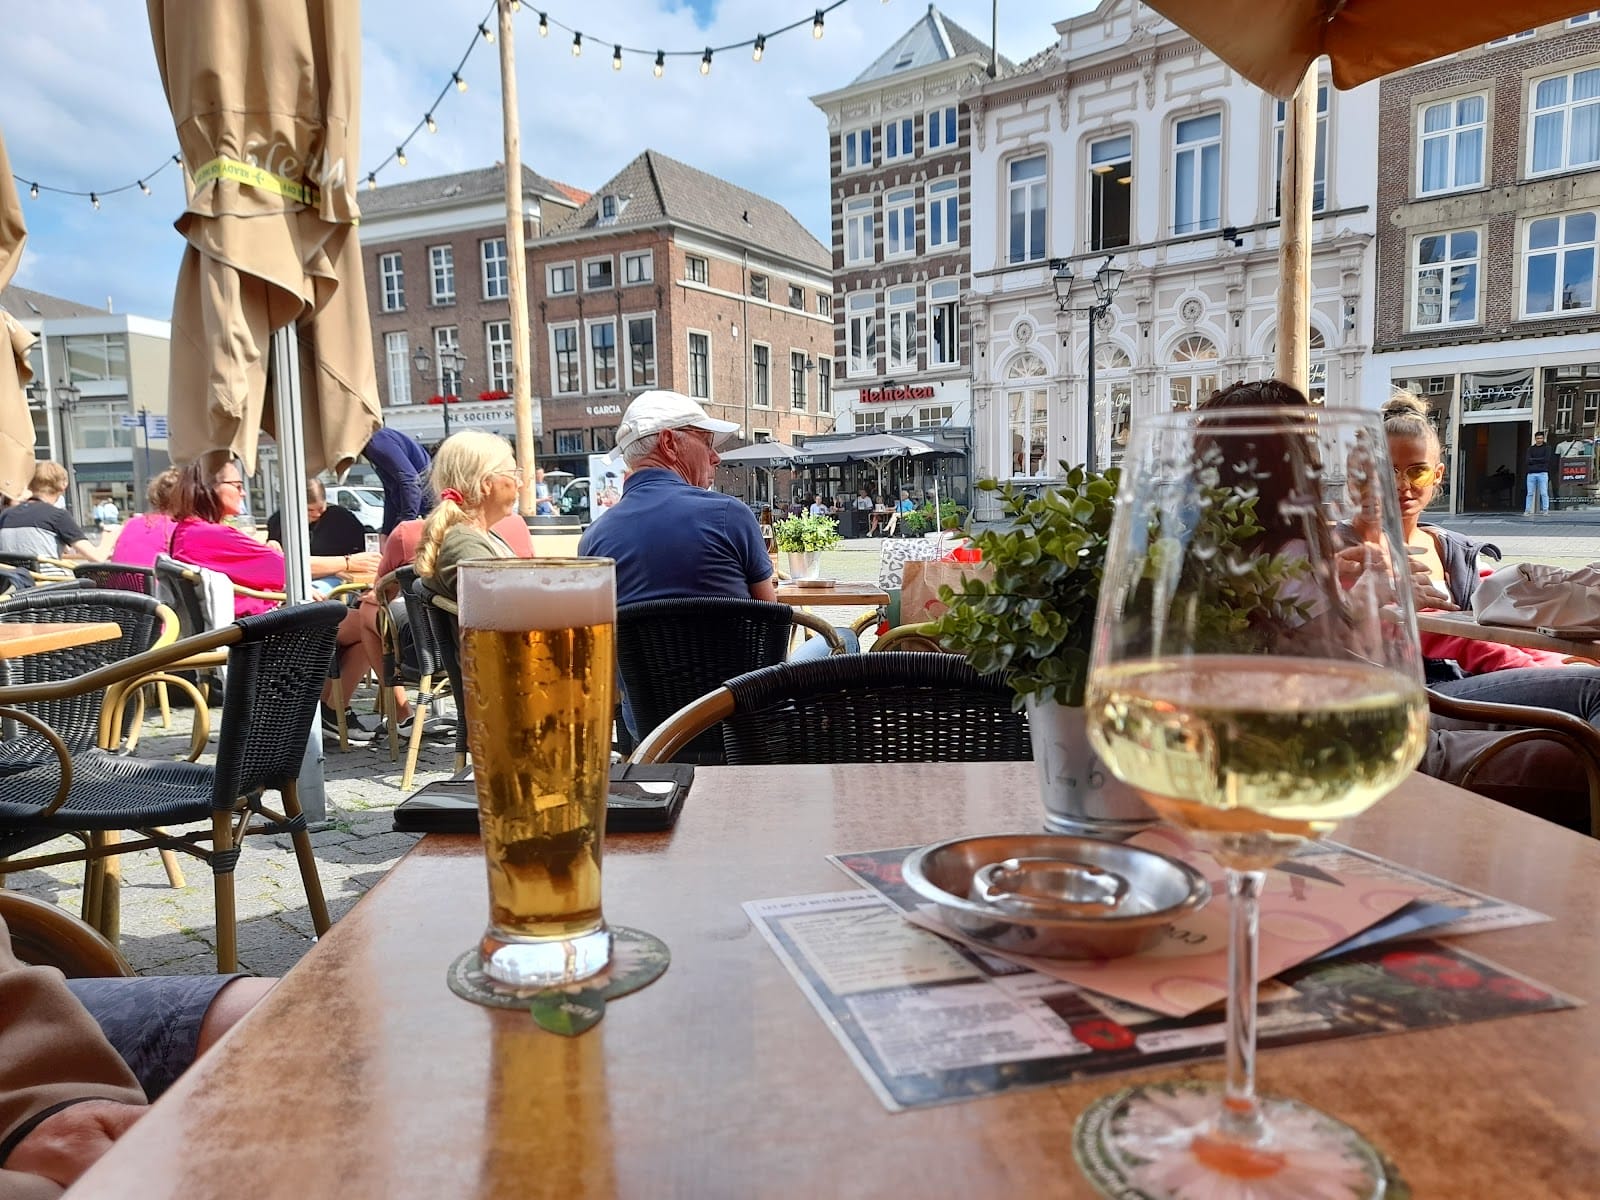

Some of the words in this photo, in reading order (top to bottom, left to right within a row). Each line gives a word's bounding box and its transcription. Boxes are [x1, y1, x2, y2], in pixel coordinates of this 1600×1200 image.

[859, 384, 935, 403] Heineken
[1462, 385, 1534, 400] ASPACT
[593, 404, 622, 415] GARCIA
[442, 414, 458, 422] HE
[464, 411, 501, 422] SOCIETY
